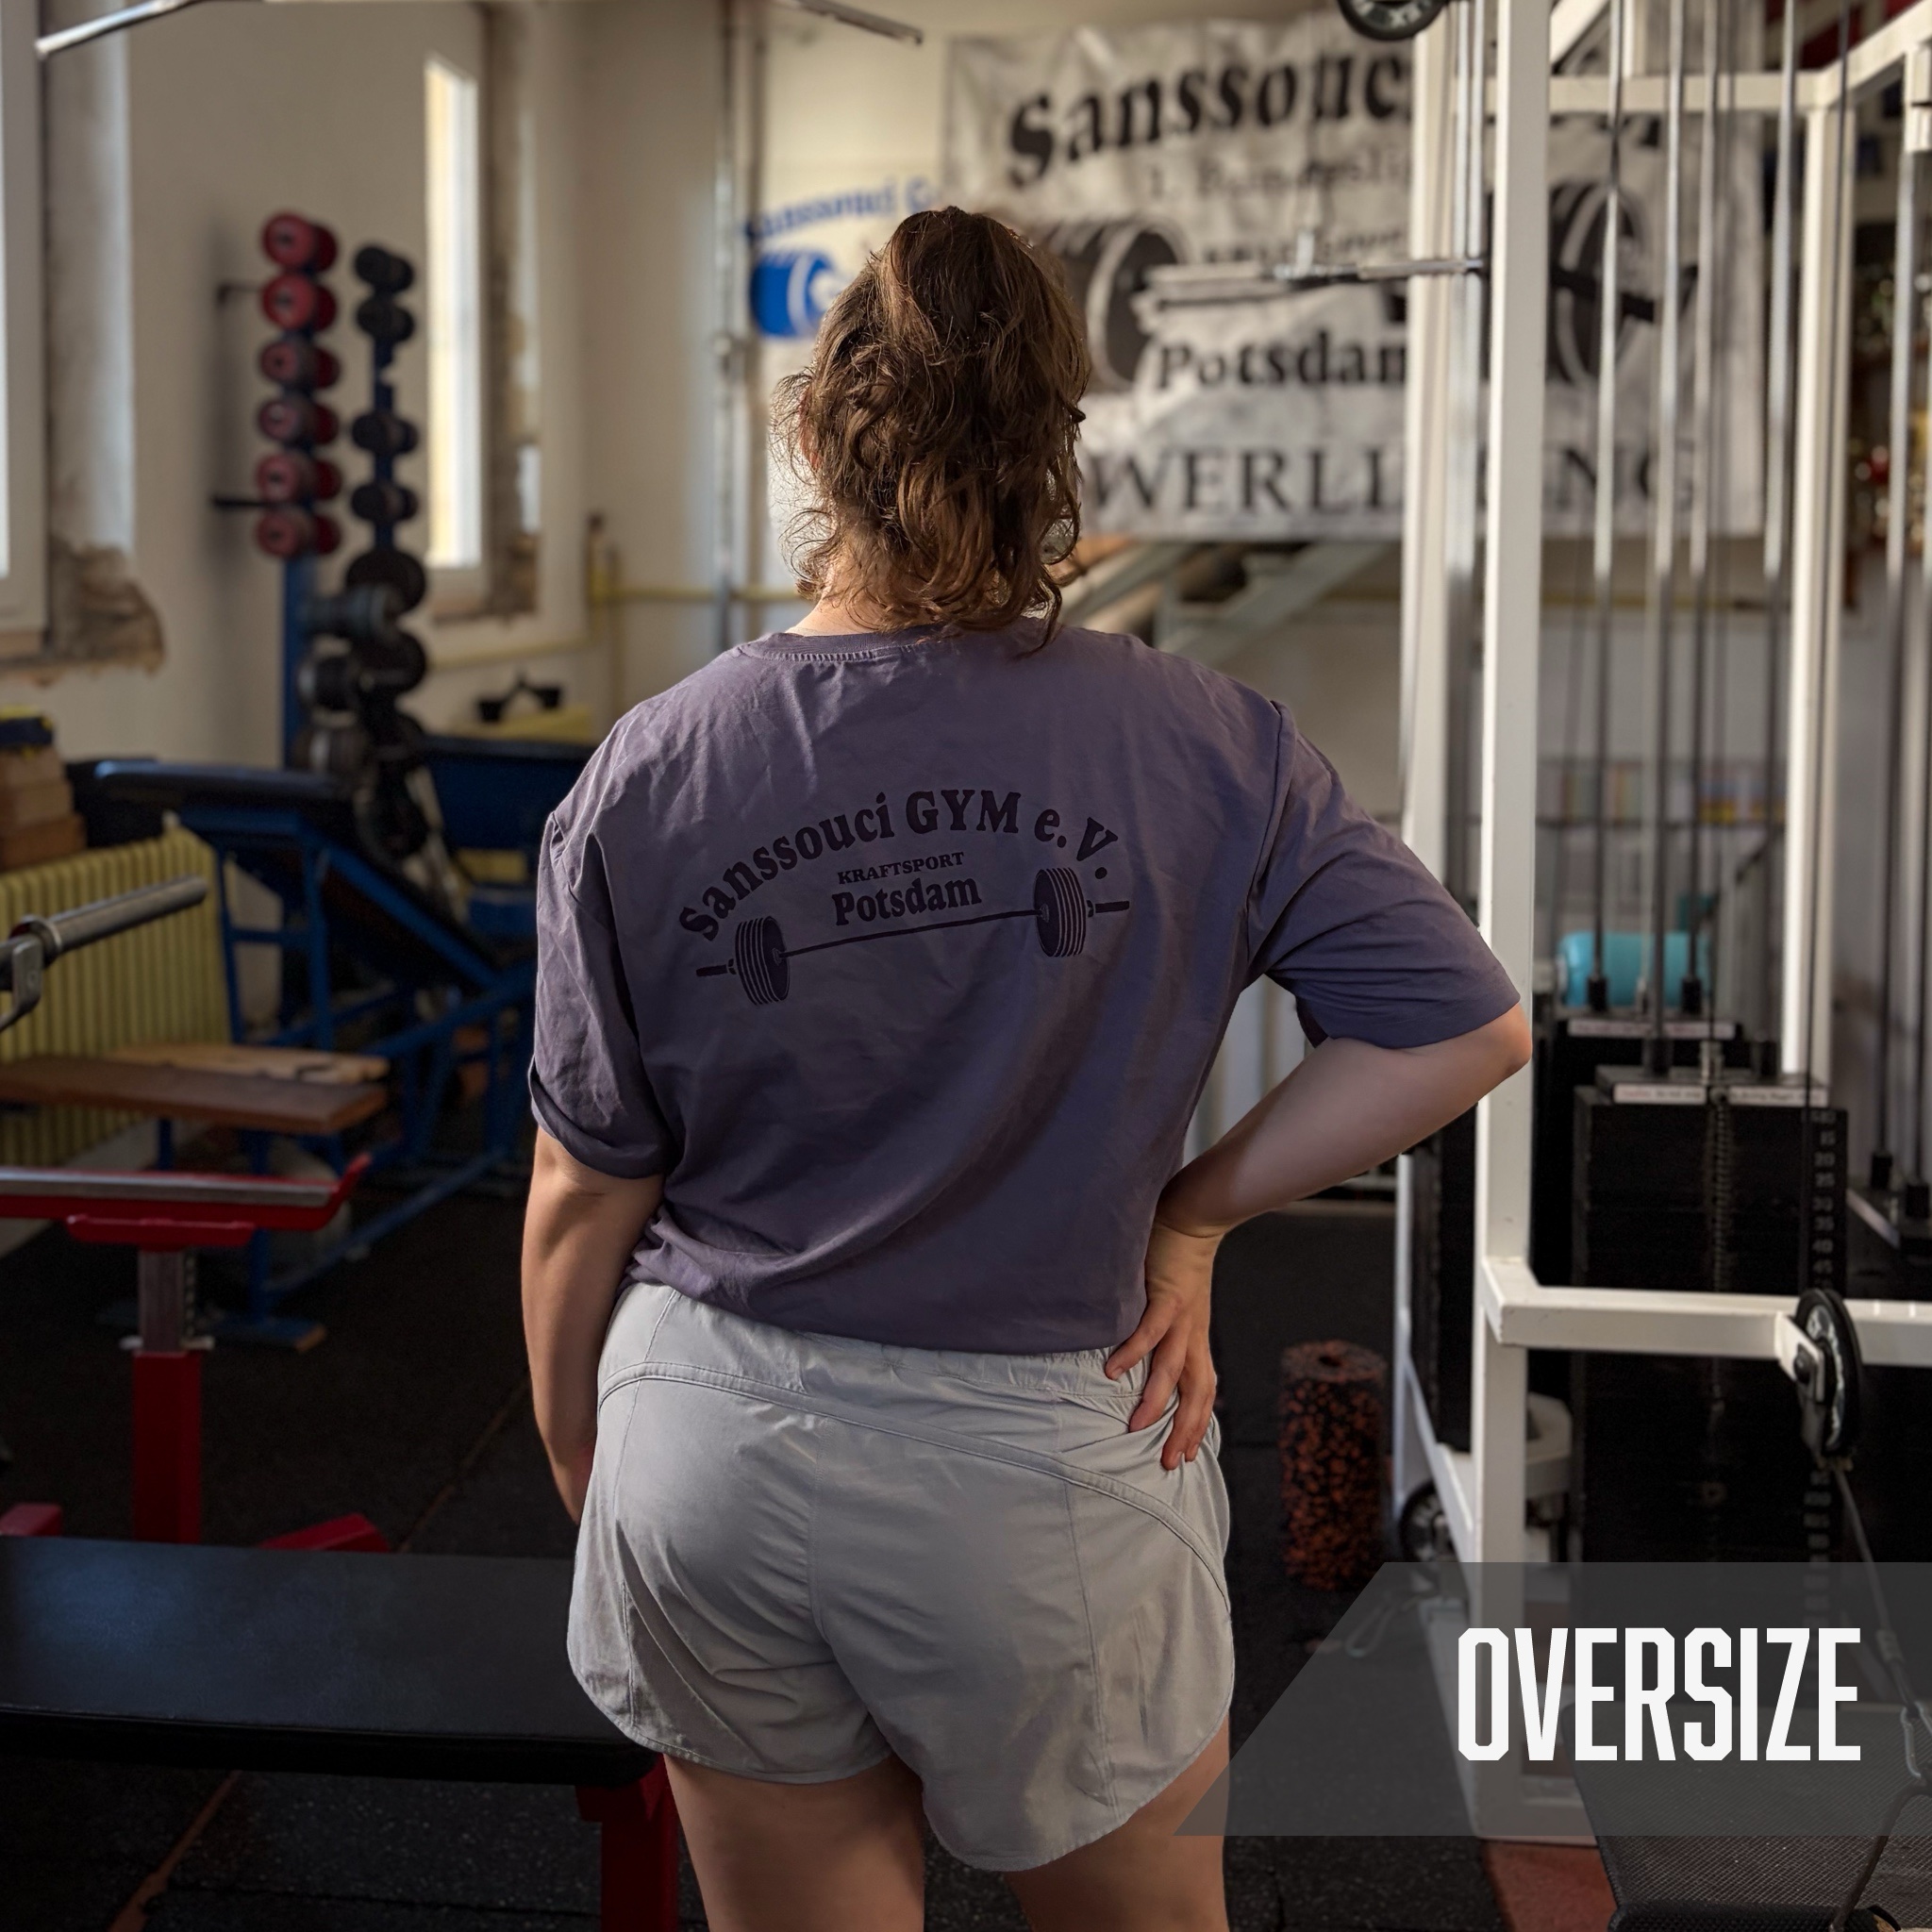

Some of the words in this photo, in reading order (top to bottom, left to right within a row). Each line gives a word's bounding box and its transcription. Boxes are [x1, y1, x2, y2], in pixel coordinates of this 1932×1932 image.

[1009, 55, 1412, 188] Sanssouc
[678, 791, 894, 941] Sanssouci
[906, 789, 1022, 834] GYM
[831, 877, 982, 926] Potsdam
[837, 851, 965, 885] KRAFTSPORT
